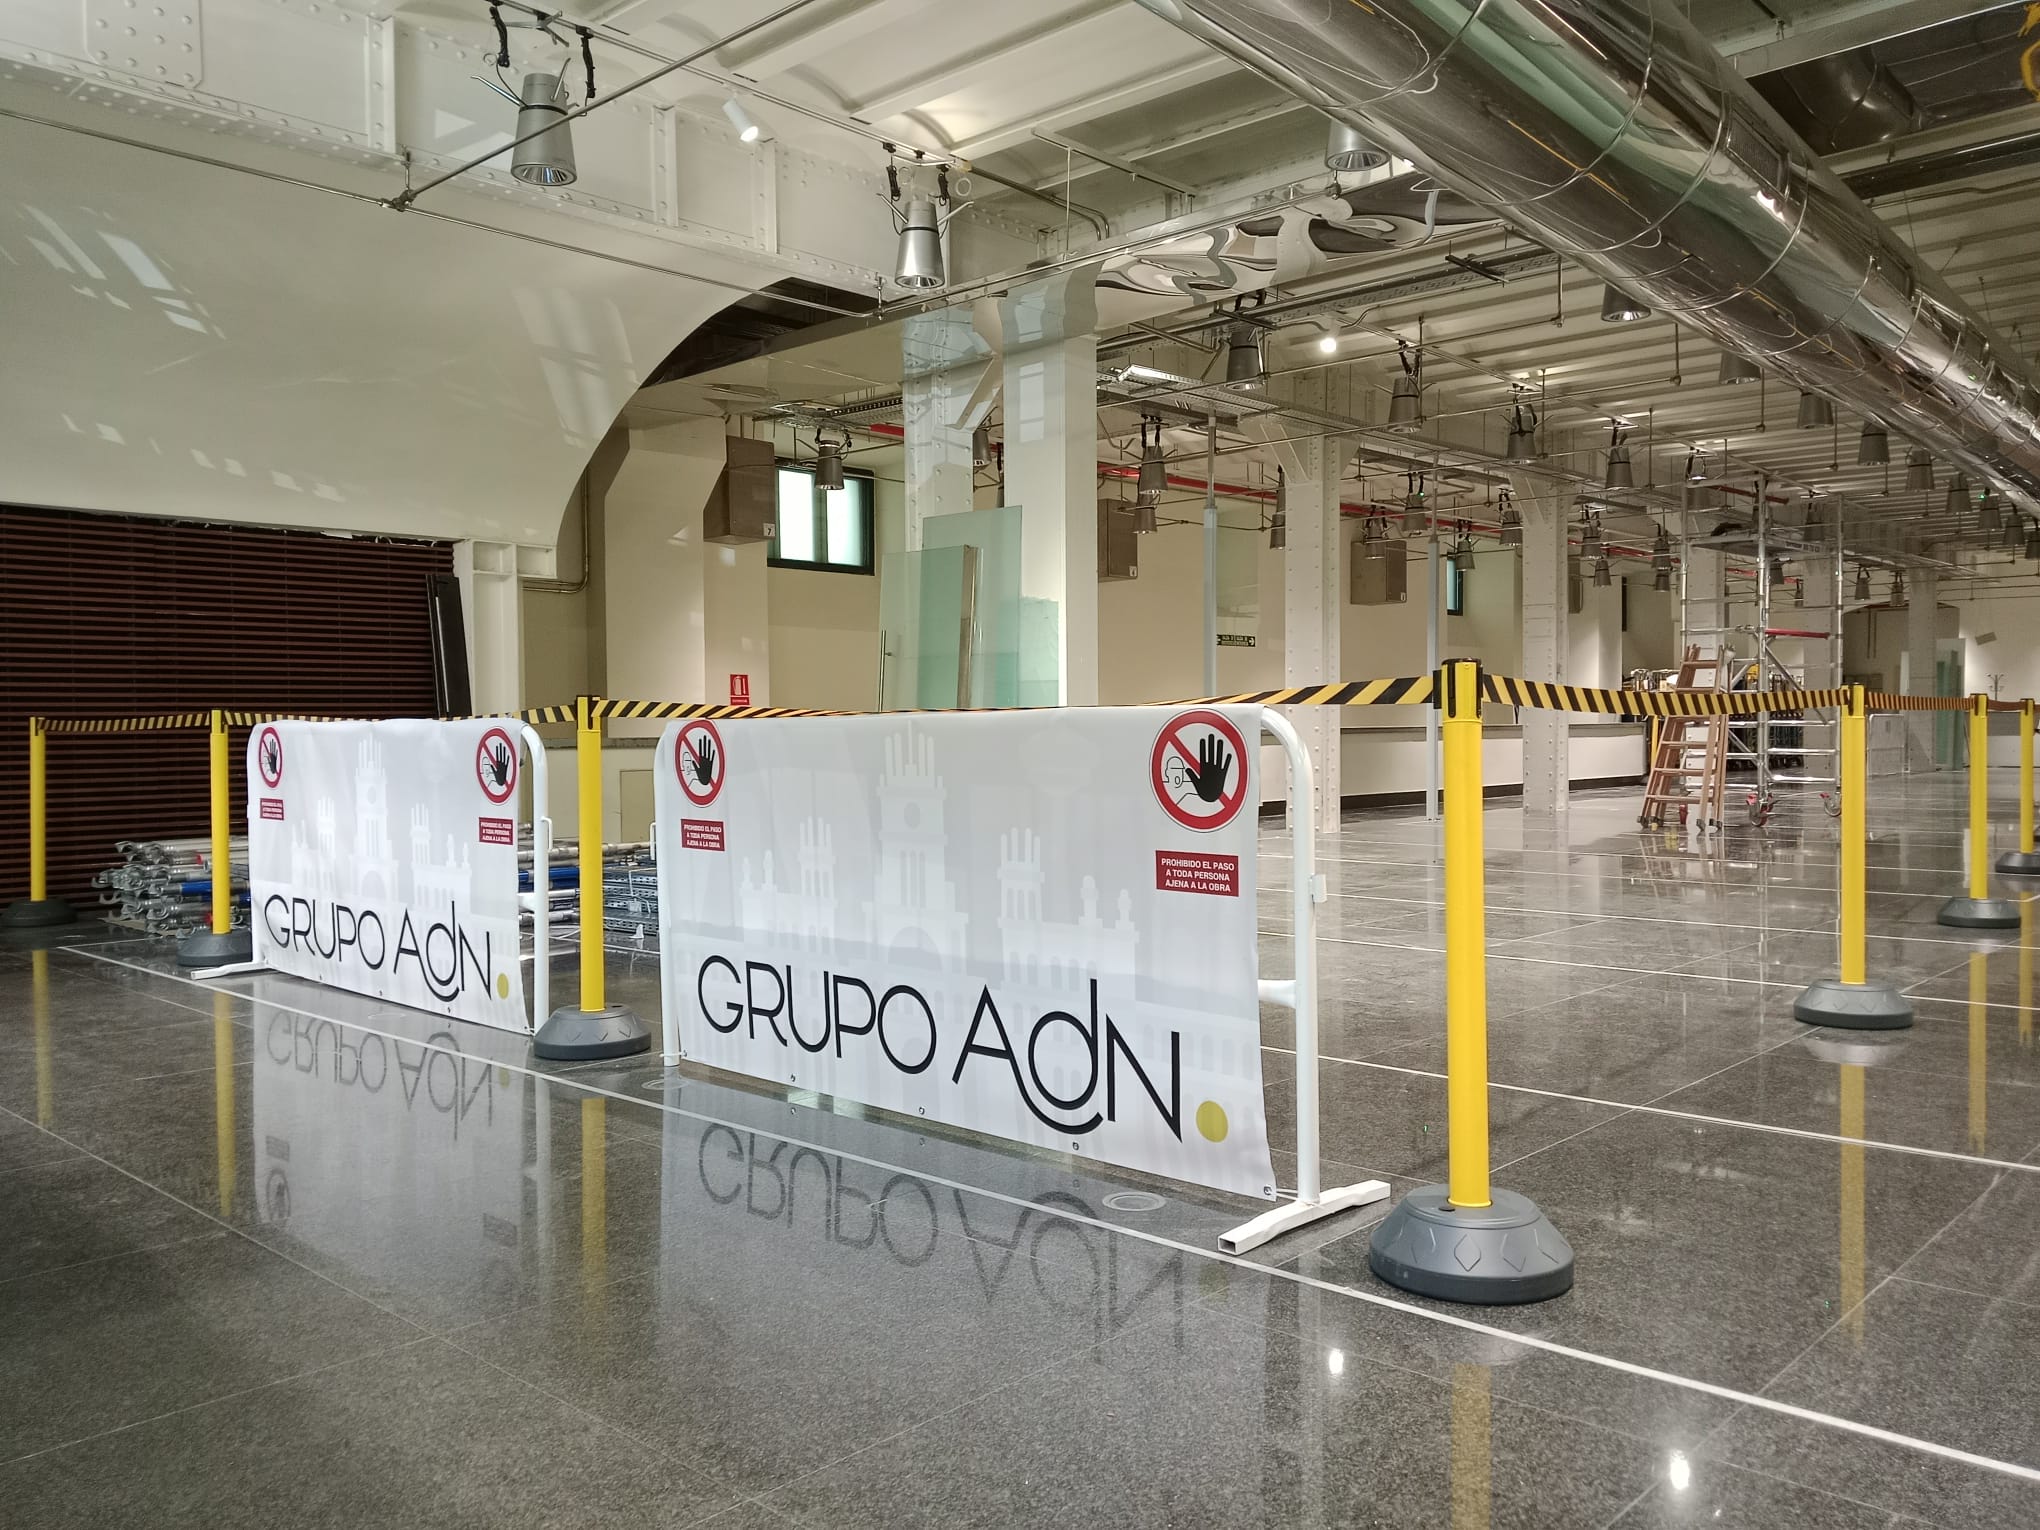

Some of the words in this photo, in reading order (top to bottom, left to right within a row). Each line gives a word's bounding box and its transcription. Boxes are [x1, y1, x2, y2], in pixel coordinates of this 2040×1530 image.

[1161, 858, 1201, 869] PROHIBIDO
[1202, 861, 1212, 869] EL
[1213, 862, 1235, 871] PASO
[1166, 869, 1171, 877] A
[1172, 869, 1193, 878] TODA
[1194, 871, 1230, 881] PERSONA
[1165, 879, 1190, 889] AJENA
[1197, 882, 1208, 890] LA
[1208, 883, 1231, 892] OBRA
[264, 894, 386, 970] GRUPO
[697, 954, 937, 1075] GRUPO
